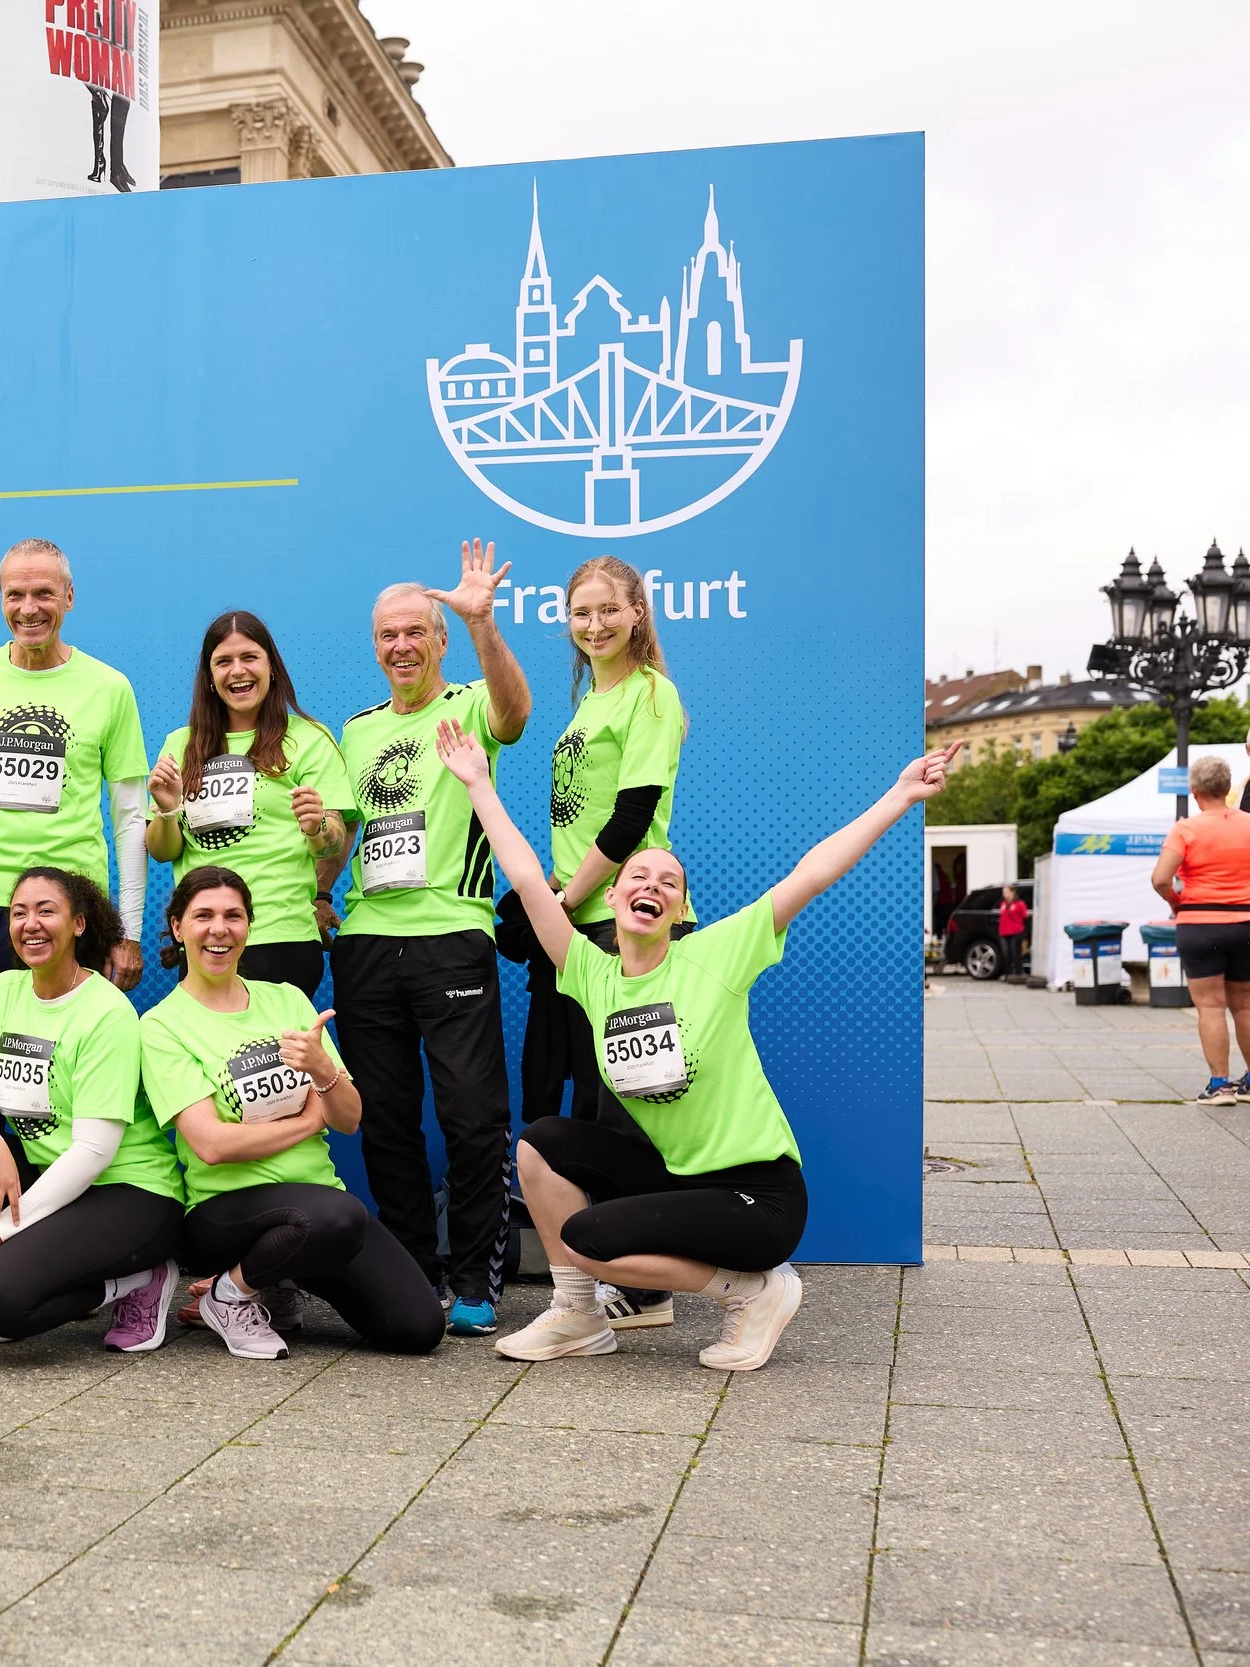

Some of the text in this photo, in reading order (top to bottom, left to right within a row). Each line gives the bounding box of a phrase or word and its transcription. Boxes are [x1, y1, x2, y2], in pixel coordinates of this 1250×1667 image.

[46, 27, 135, 101] WOMAN
[490, 569, 747, 624] Frafurt
[363, 835, 421, 865] 55023
[456, 986, 483, 997] hummel
[607, 1030, 675, 1064] 55034
